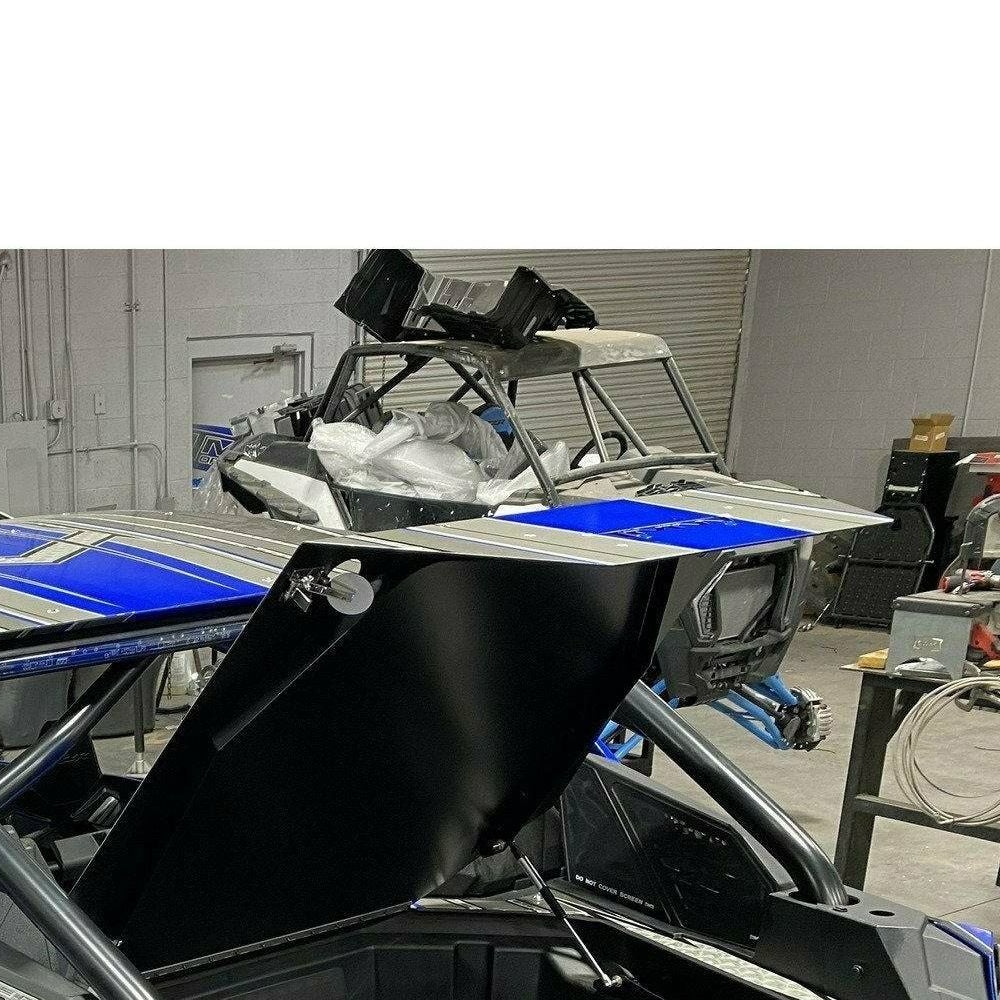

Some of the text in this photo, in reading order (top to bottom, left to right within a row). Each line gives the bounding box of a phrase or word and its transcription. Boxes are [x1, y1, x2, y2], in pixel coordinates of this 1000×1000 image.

[575, 874, 584, 882] DO
[585, 877, 597, 887] NOT
[598, 883, 618, 896] COVER
[619, 891, 644, 905] SCREEN
